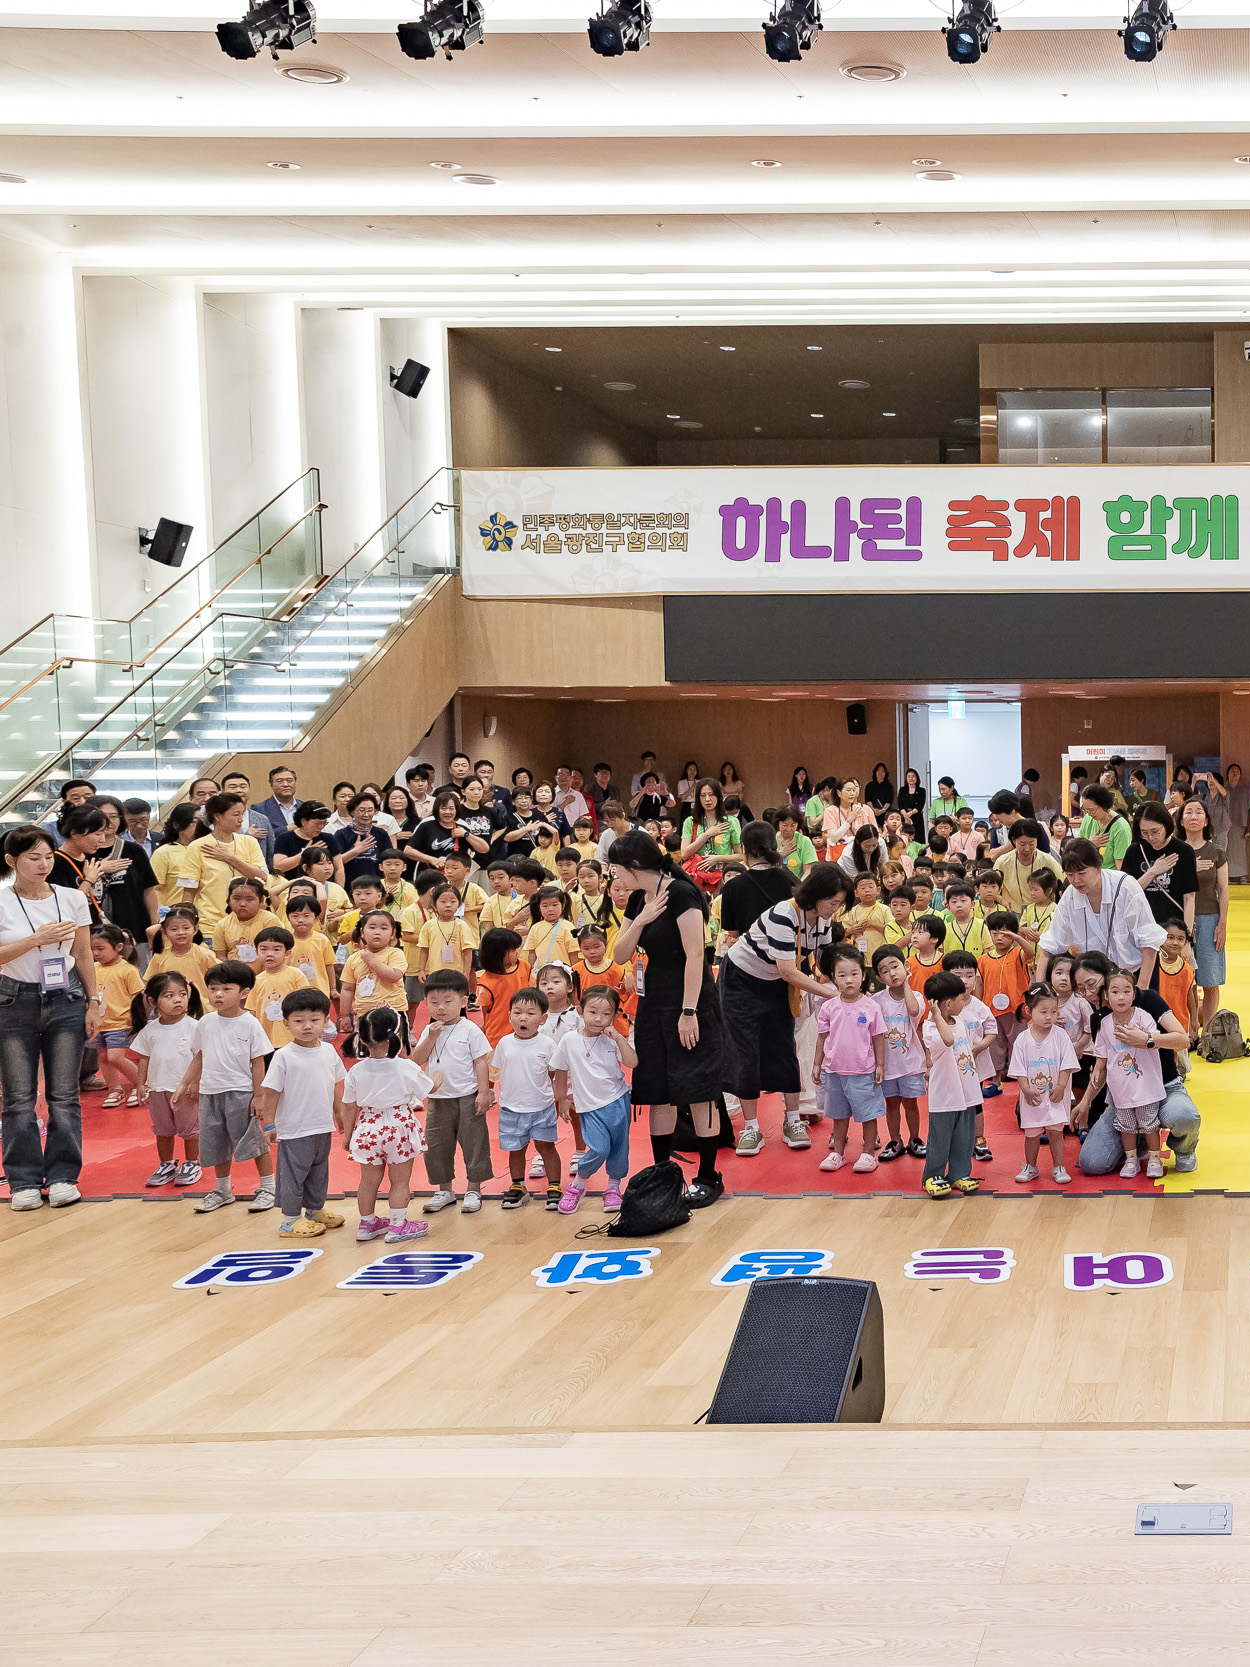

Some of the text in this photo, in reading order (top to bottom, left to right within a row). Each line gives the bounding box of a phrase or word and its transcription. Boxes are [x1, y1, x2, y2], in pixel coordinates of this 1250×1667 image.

[521, 512, 690, 532] 민주평화통일자문회의
[719, 497, 922, 562] 하나된
[946, 496, 1080, 561] 축제
[1103, 495, 1238, 560] 함께
[520, 531, 689, 555] 서울광진구협의회
[192, 1251, 313, 1284] 일
[542, 1251, 652, 1284] 화
[1074, 1256, 1164, 1287] 여
